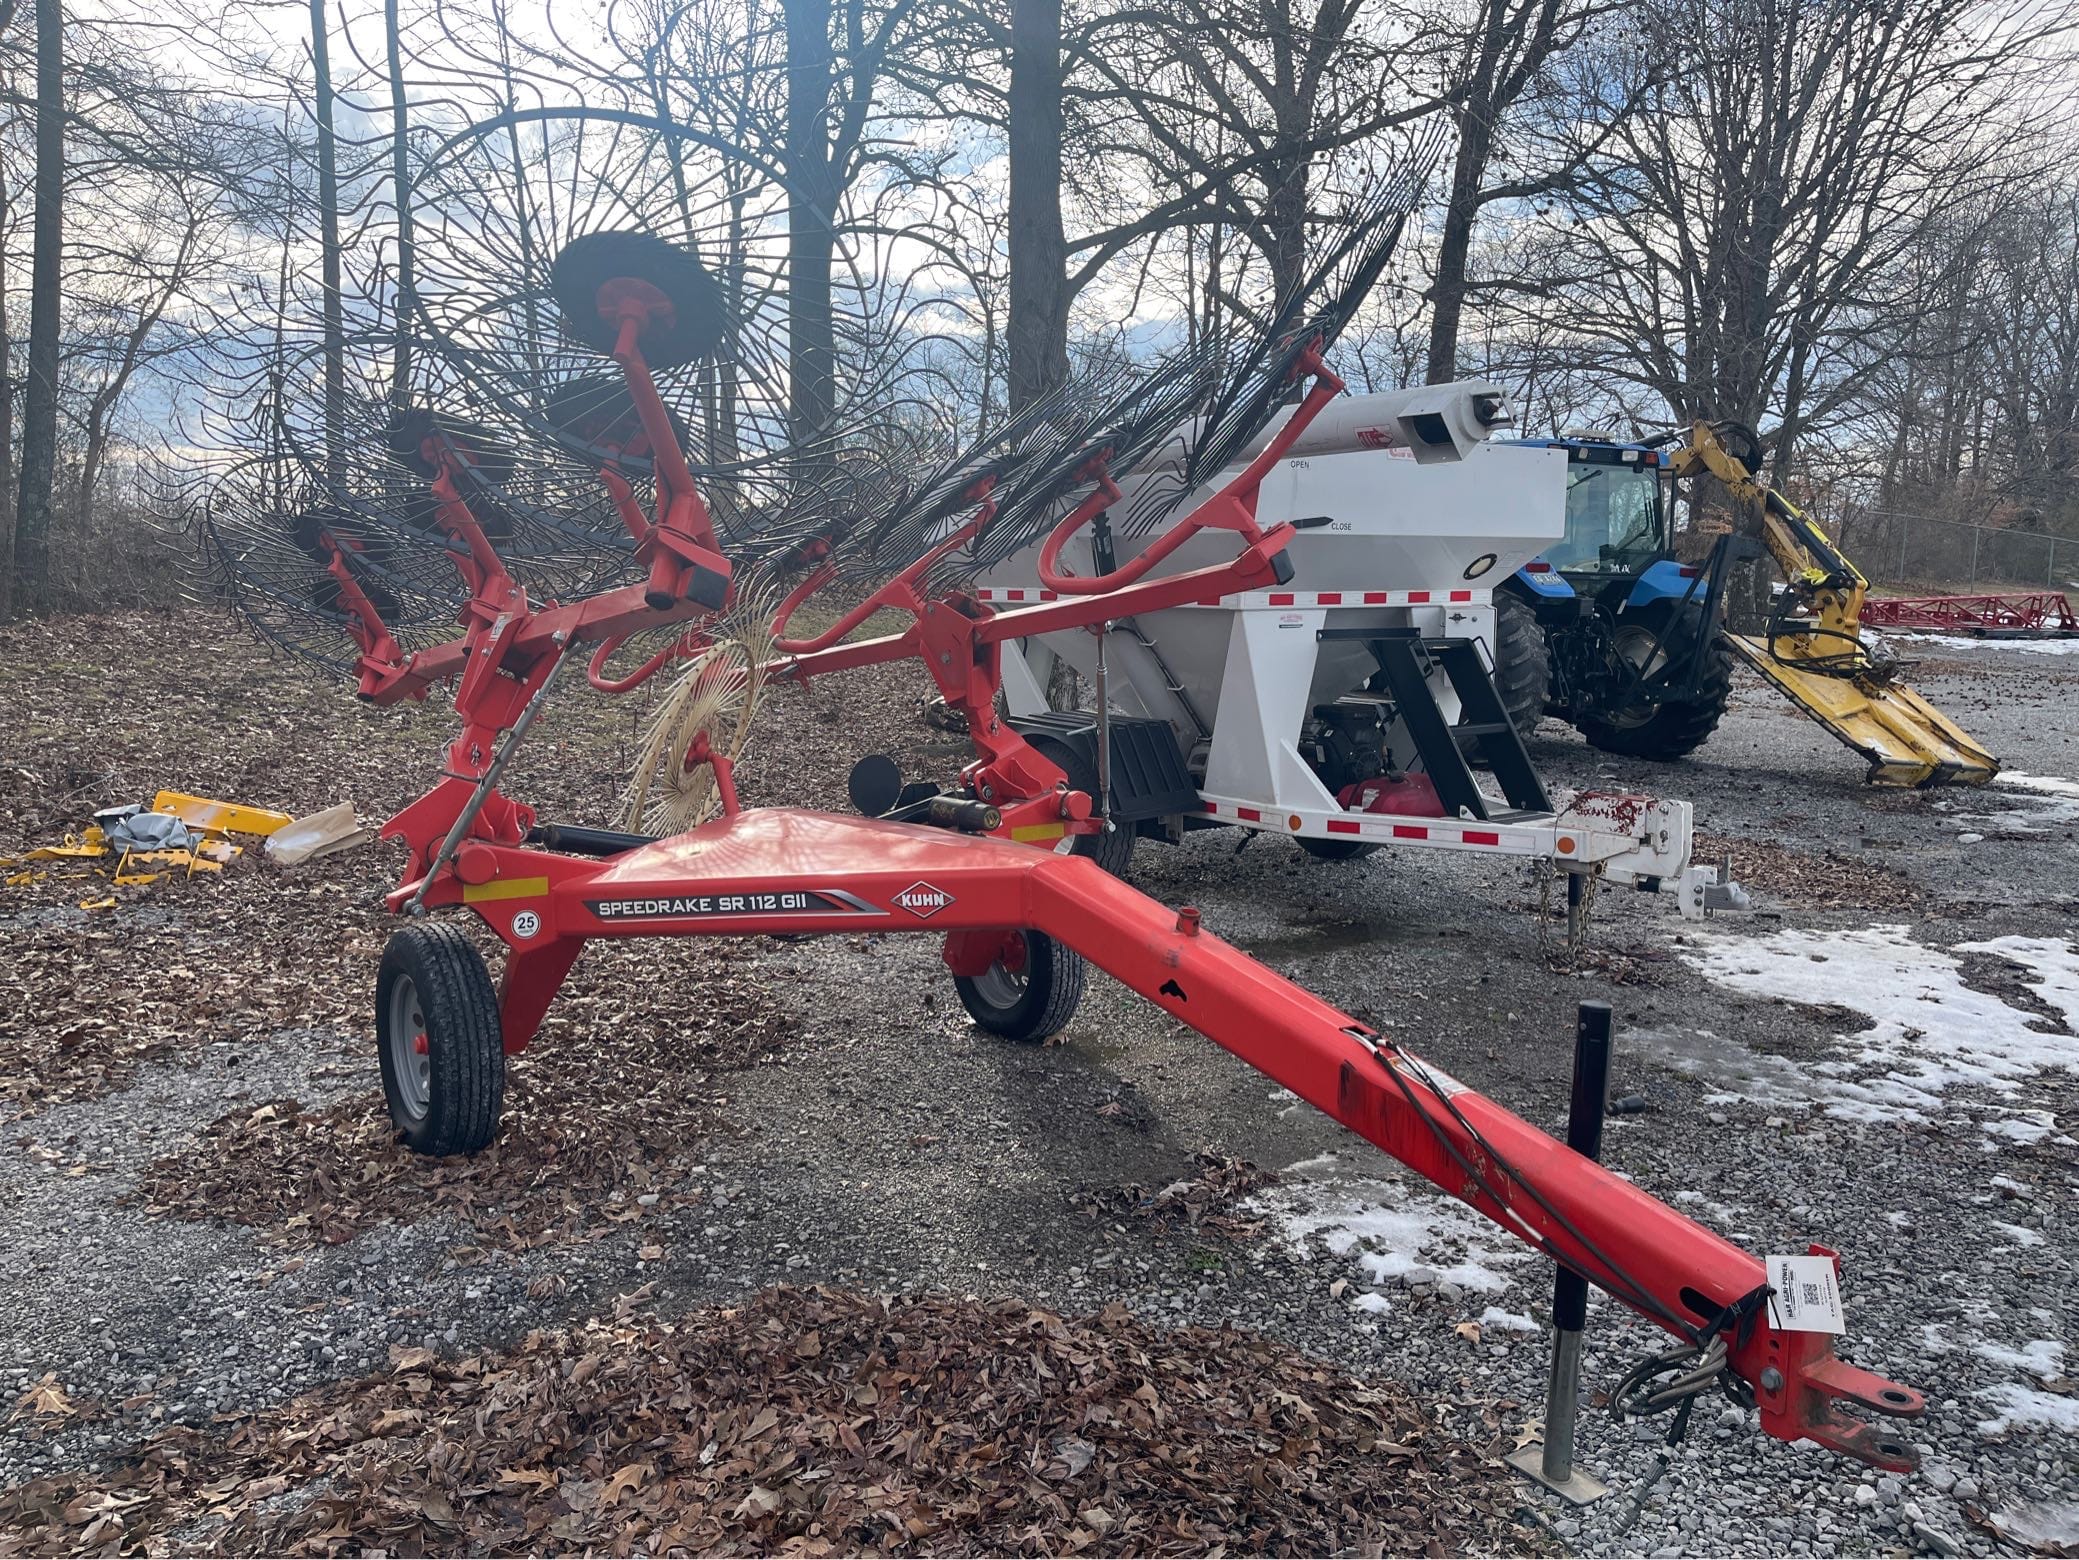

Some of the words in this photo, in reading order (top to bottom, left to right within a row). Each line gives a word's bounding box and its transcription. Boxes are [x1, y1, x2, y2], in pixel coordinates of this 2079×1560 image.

[1290, 460, 1310, 469] OPEN
[1331, 522, 1352, 531] CLOSE
[599, 897, 713, 917] SPEEDRAKE
[719, 896, 746, 912] SR
[750, 895, 777, 910] 112
[782, 893, 807, 909] GII
[901, 893, 946, 908] KUHN
[517, 916, 535, 929] 25
